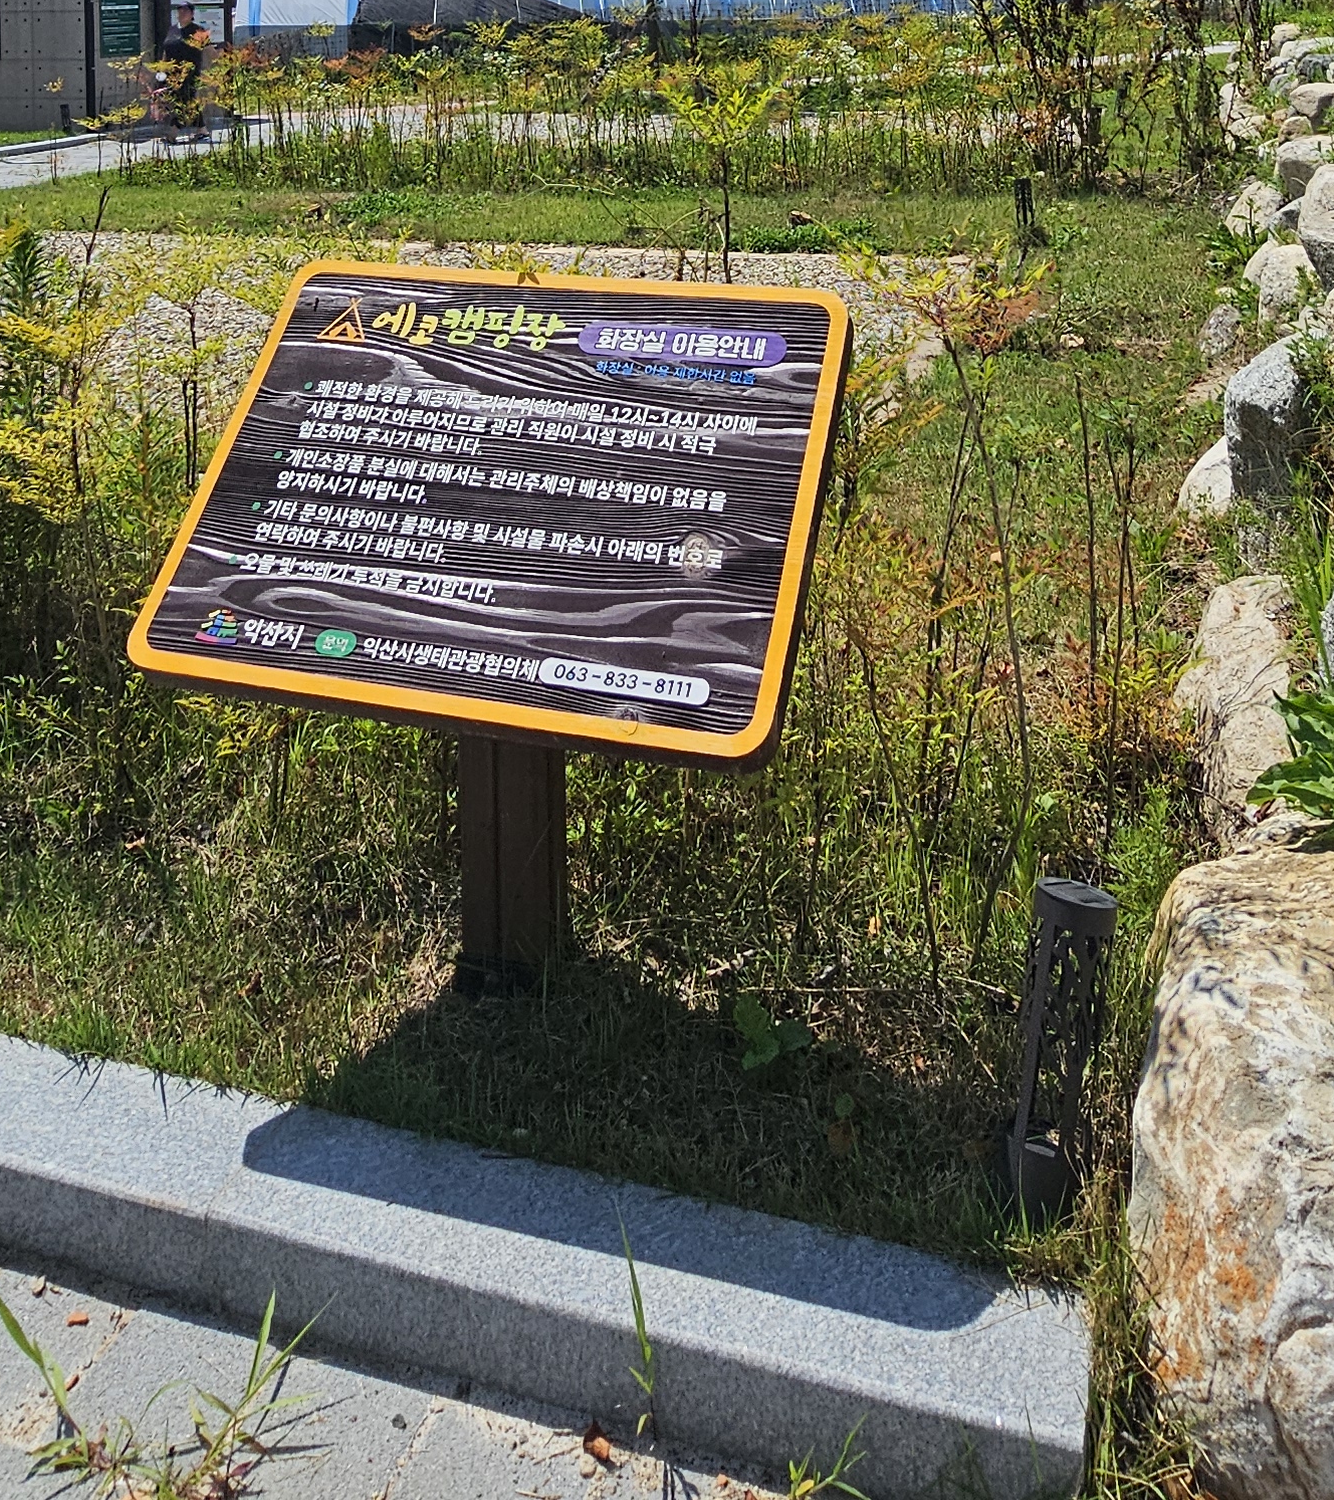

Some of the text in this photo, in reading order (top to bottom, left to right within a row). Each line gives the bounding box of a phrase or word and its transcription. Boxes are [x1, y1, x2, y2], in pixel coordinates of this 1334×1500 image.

[595, 328, 767, 361] 화장실 이용안내
[596, 361, 634, 377] 화장실
[673, 366, 726, 382] 제한시간
[729, 371, 756, 385] 없음
[307, 400, 717, 456] 시설 정비가 이루어지므로 관리 직원이 시설 정비 시 적극
[315, 379, 757, 435] 쾌적한 환경을 제공해 드리기 위하여 매일 12시~14시 사이에
[298, 420, 482, 456] 협조하여 주시기 바랍니다.
[276, 469, 427, 505] 양지하시기 바랍니다.
[286, 448, 727, 512] 개인소장품 분실에 대해서는 관리주체의 배상책임이 없음을
[255, 521, 447, 563] 연락하여 주시기 바랍니다.
[264, 500, 723, 569] 기타 문의사항이나 불편사항 및 시설물 파손시 아래의 번호로
[240, 552, 276, 574] 오물
[277, 557, 297, 576] 및
[297, 560, 349, 583] 쓰레기
[405, 575, 497, 603] 금지합니다.
[243, 618, 306, 650] 익산시
[363, 637, 540, 682] 익산시생태관광협의체
[554, 663, 693, 698] 063-833-8111
